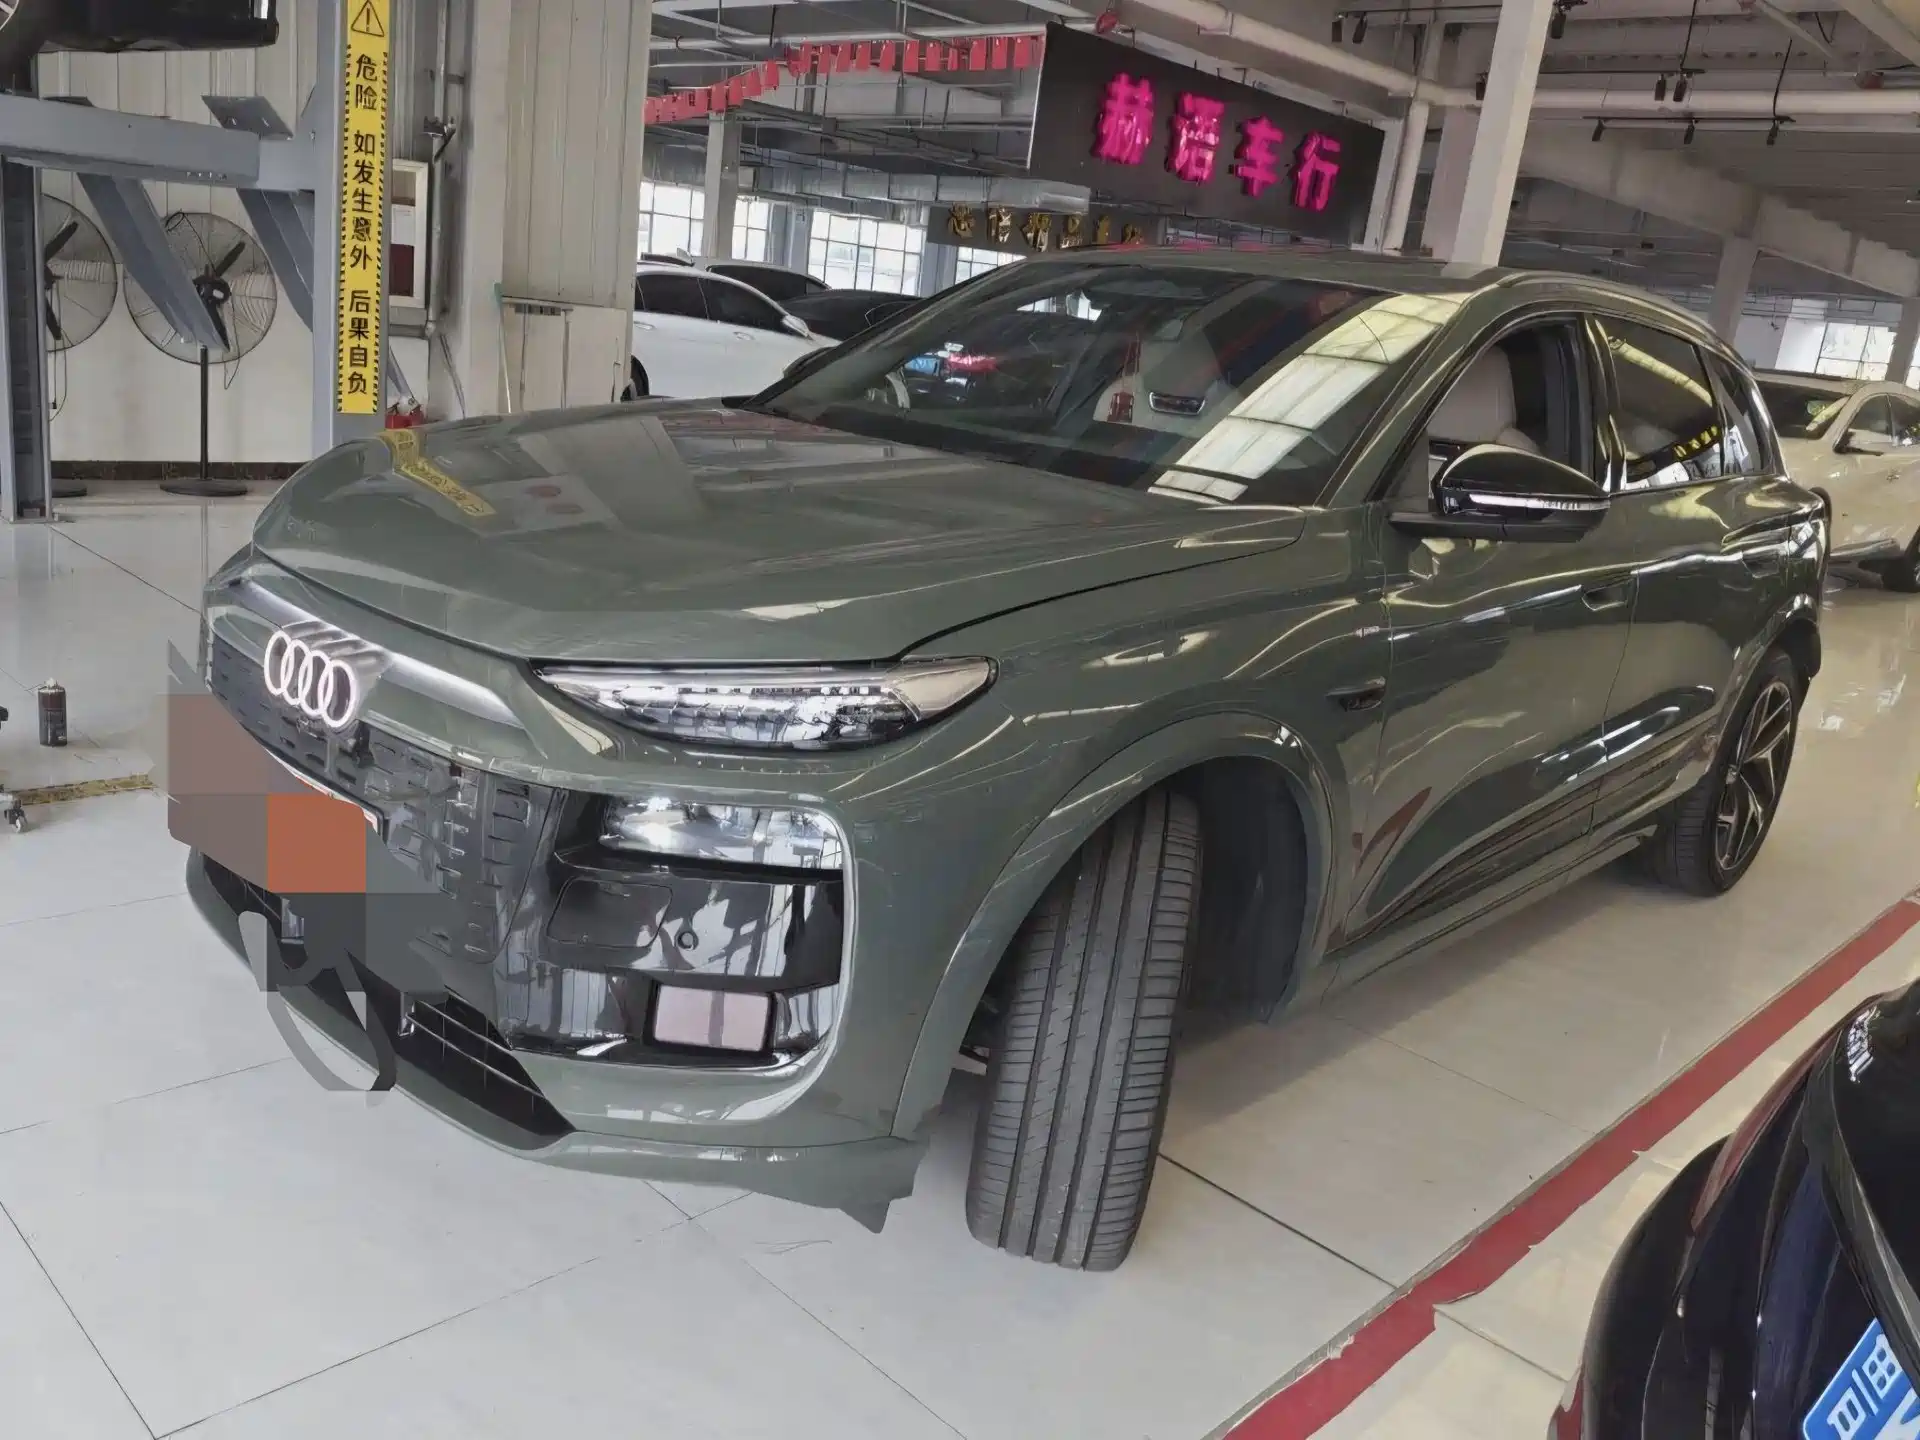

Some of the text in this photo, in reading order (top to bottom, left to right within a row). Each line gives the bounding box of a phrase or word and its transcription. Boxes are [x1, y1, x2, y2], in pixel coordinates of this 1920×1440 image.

[347, 53, 378, 395] 危险 如发生意外 后果自负
